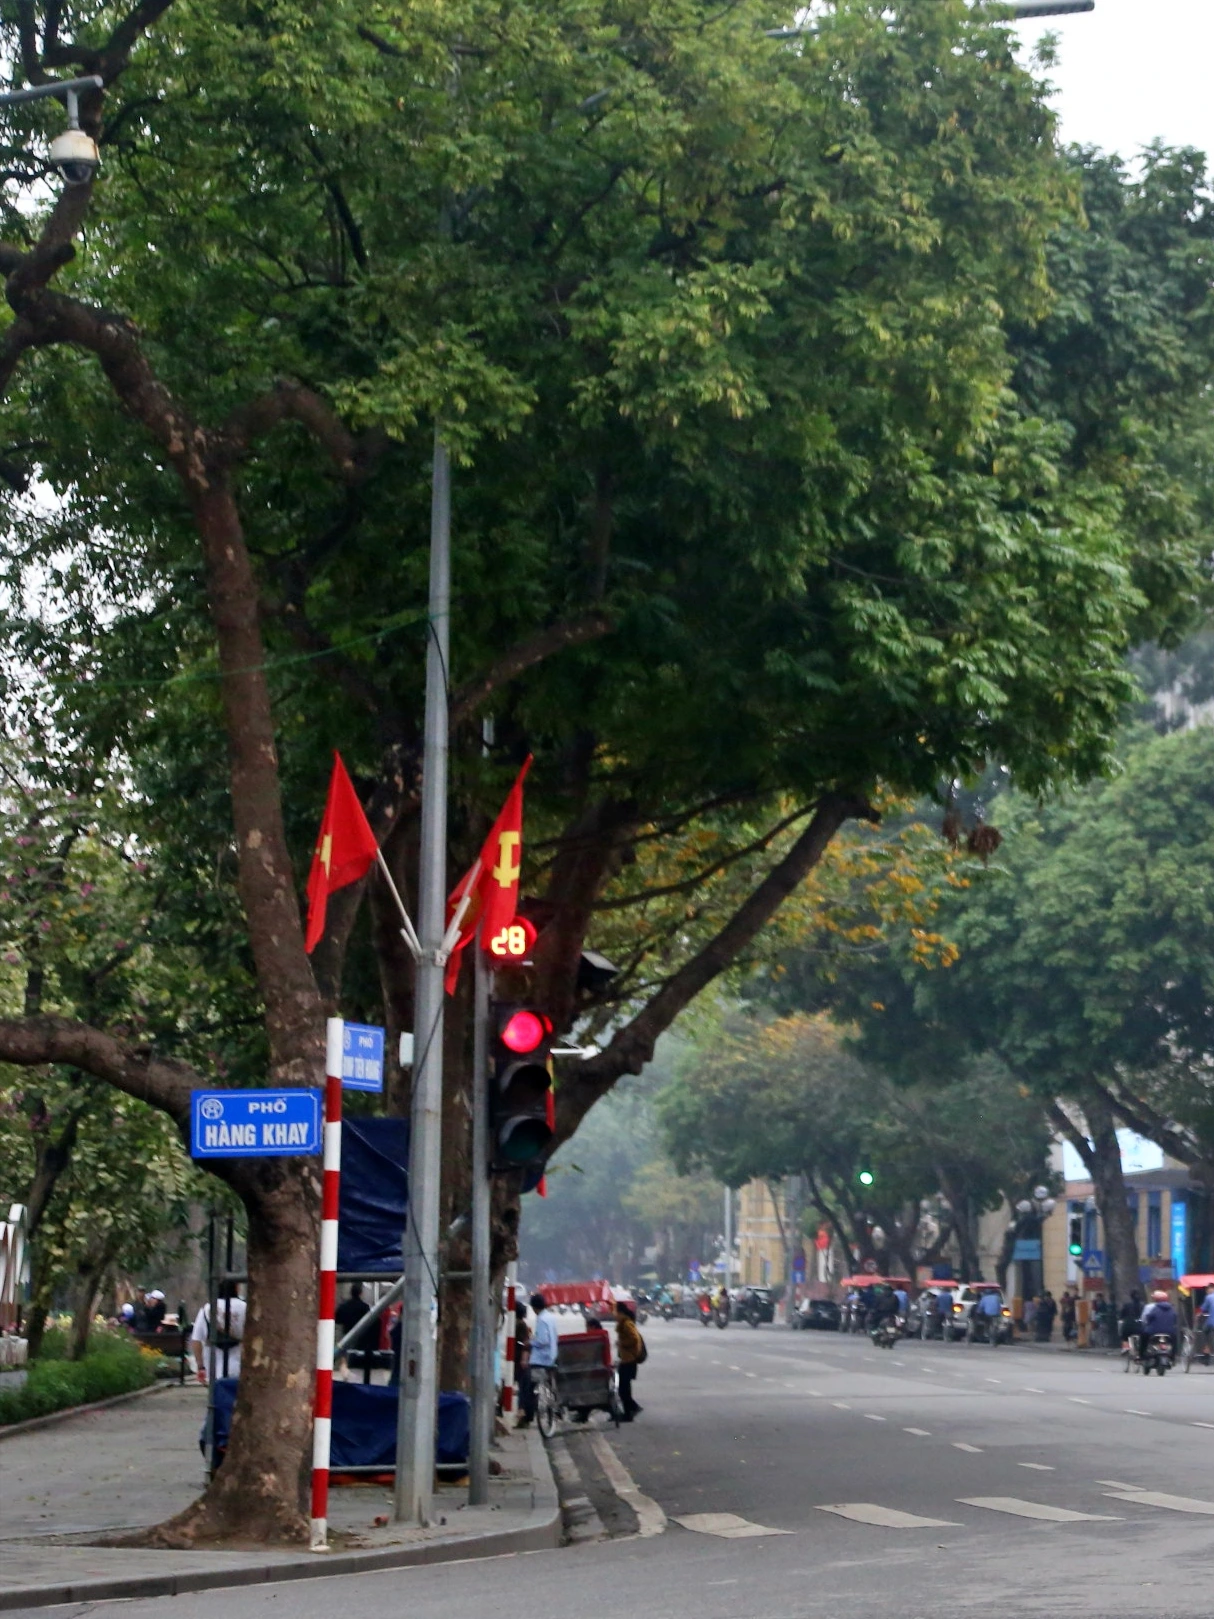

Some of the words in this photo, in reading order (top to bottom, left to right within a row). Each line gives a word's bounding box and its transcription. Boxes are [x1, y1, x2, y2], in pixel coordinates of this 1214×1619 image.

[491, 926, 526, 955] 28
[248, 1097, 287, 1114] PHỐ
[205, 1120, 256, 1147] HÀNG
[262, 1122, 309, 1146] KHAY
